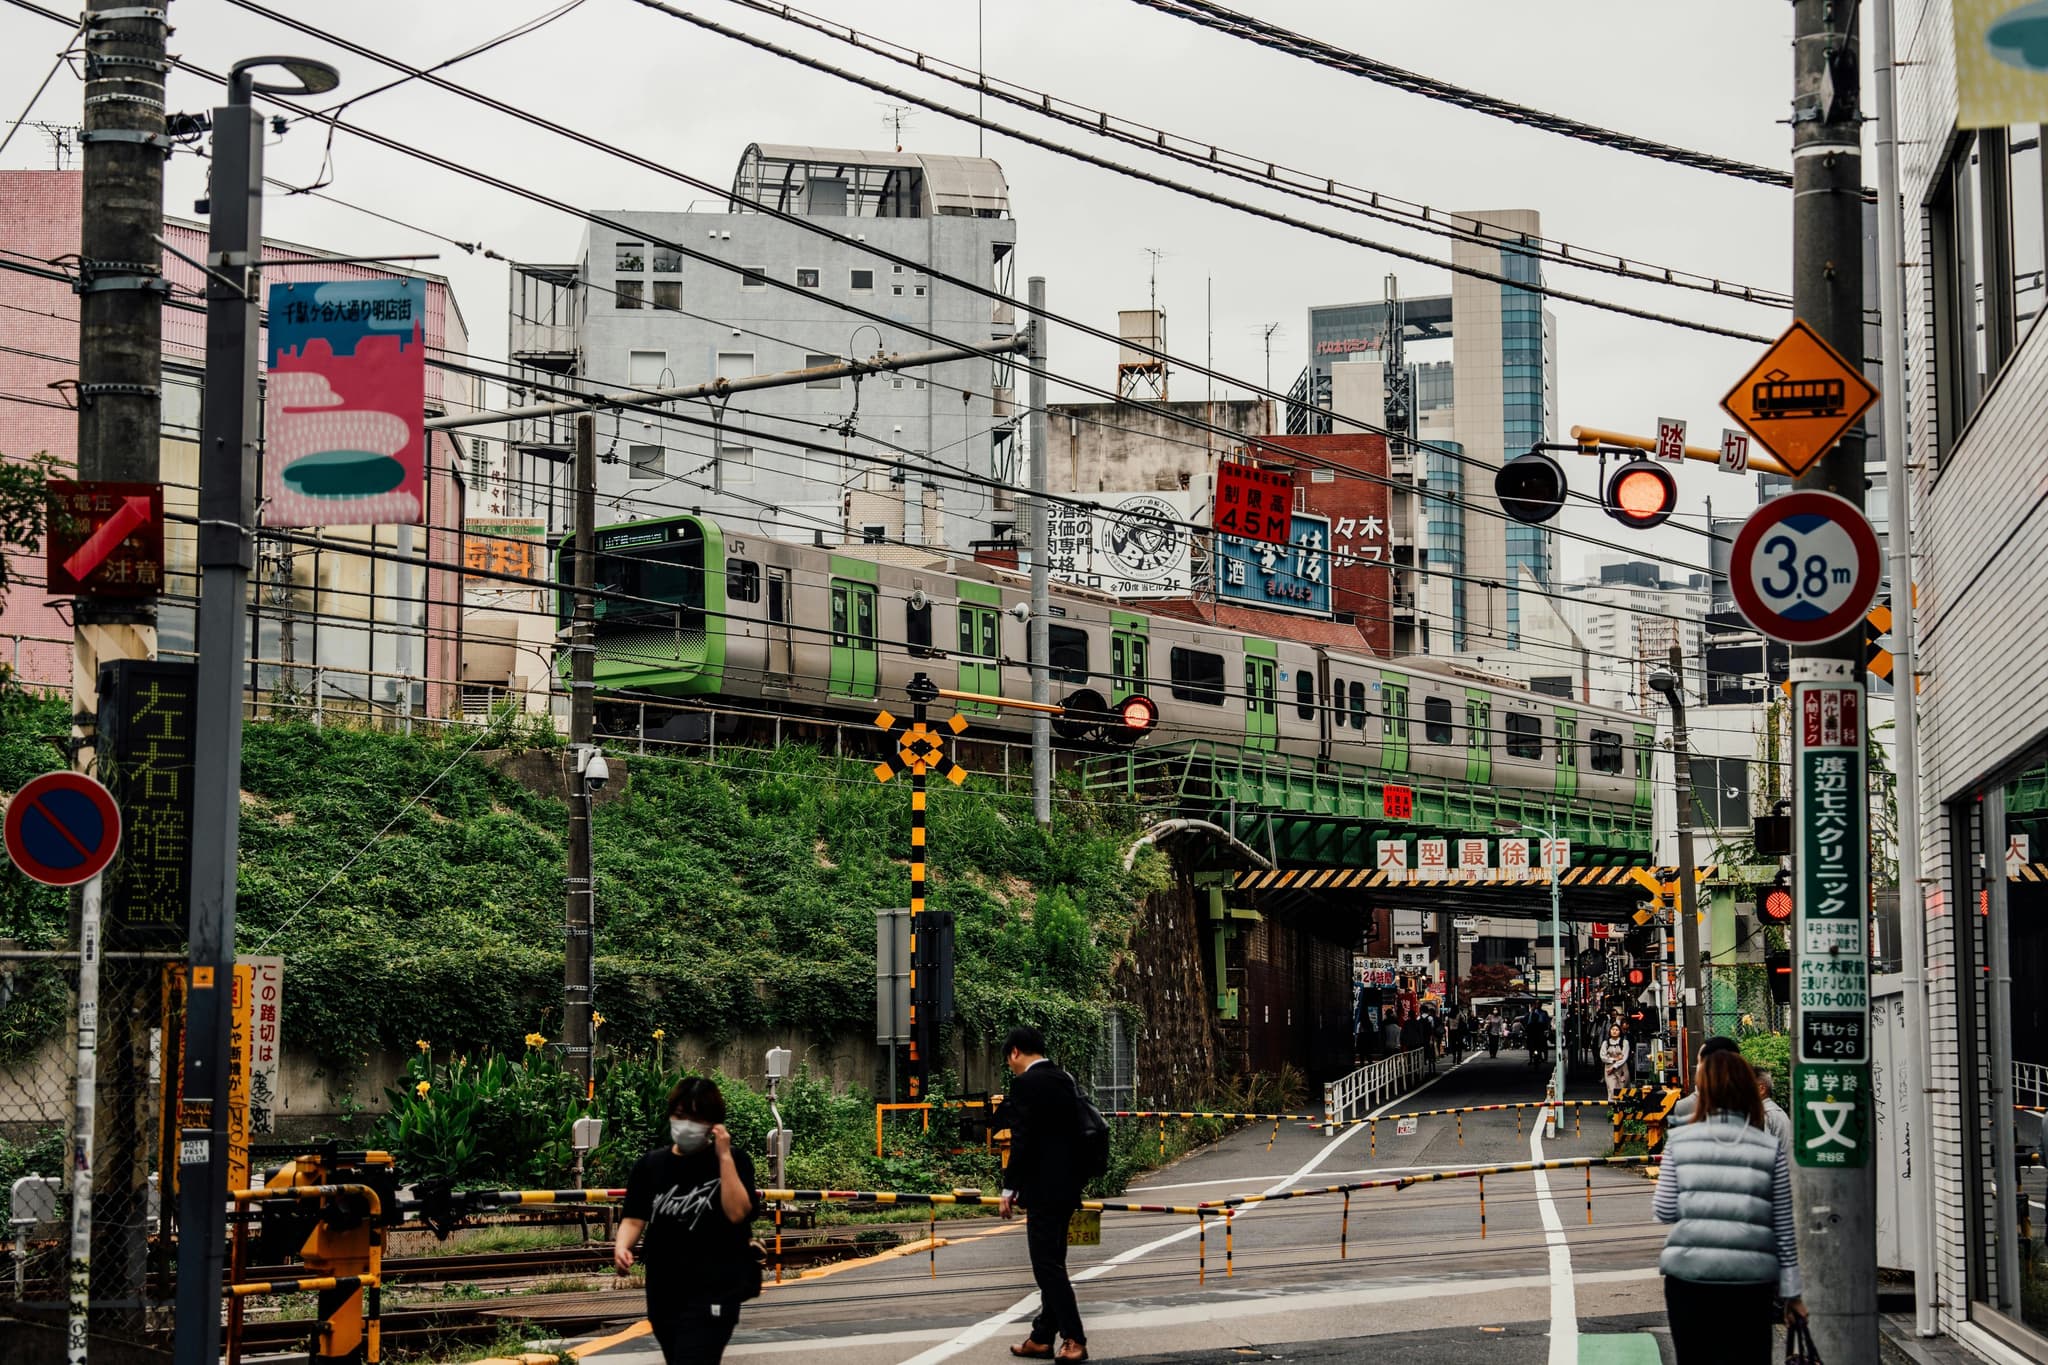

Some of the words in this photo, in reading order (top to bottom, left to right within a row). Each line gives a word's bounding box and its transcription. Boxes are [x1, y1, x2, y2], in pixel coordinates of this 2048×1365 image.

[1658, 424, 1748, 471] 踏切
[1221, 508, 1284, 540] 4.5M
[729, 540, 745, 555] JR
[1266, 579, 1313, 601] きんりょう
[1806, 692, 1819, 744] 人間ドック
[1843, 692, 1856, 743] 内科
[129, 682, 187, 921] 左右確認
[1814, 756, 1848, 915] 渡辺七六クリニック
[1380, 842, 1567, 867] 大型最徐行
[1802, 960, 1865, 974] 代々木駅前
[1801, 993, 1866, 1006] 3376-0076
[259, 965, 277, 1062] この踏切は
[1809, 1023, 1859, 1036] 千駄ヶ谷
[1812, 1041, 1856, 1053] 4-26
[1804, 1074, 1857, 1091] 通学路
